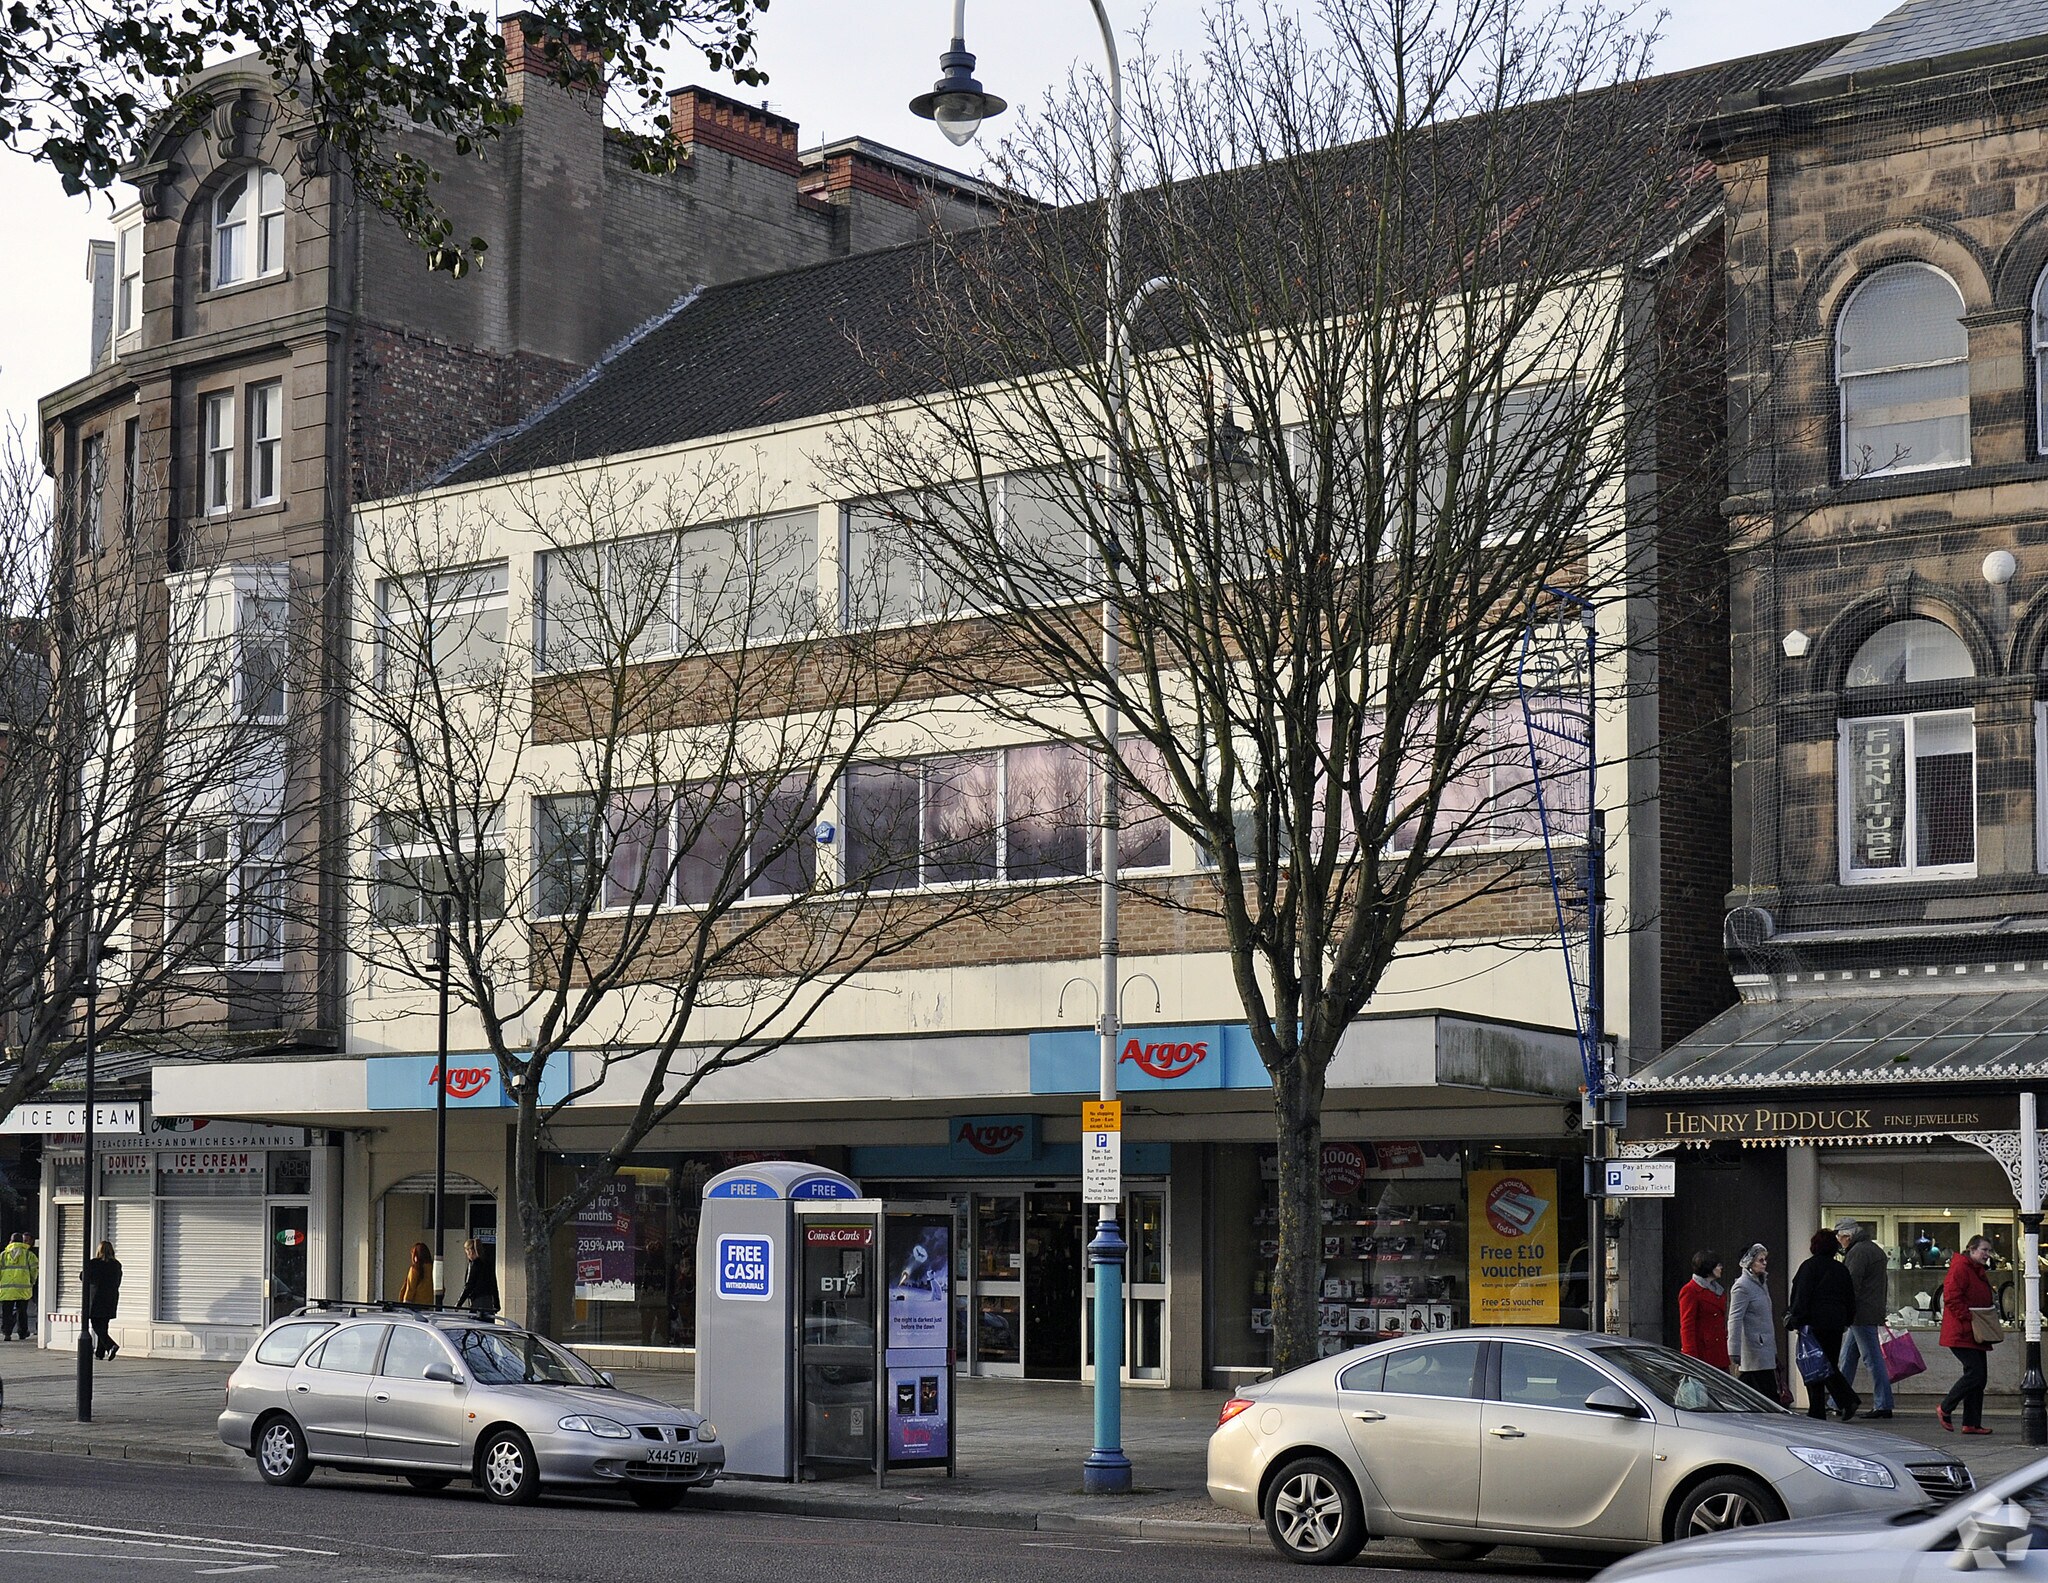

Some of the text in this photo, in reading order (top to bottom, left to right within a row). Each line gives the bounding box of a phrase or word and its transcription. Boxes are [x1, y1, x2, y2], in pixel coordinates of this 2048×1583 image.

[1865, 728, 1892, 860] FURNITURE
[1118, 1037, 1209, 1079] Argos
[22, 1111, 52, 1126] ICE
[1884, 1115, 1912, 1126] FINE
[1913, 1113, 1979, 1128] JEWELLERS
[97, 1136, 294, 1149] TEA COFFEE SANDWICHES PANINIS
[955, 1122, 1025, 1155] Argos
[108, 1155, 147, 1169] DONUTS
[175, 1153, 248, 1167] ICE CREAM
[1321, 1150, 1361, 1168] 1000s
[617, 1182, 627, 1193] to
[730, 1184, 757, 1196] FREE
[811, 1184, 836, 1197] FREE
[1490, 1184, 1504, 1198] Free
[1503, 1181, 1530, 1194] voucher
[598, 1196, 612, 1207] for
[613, 1196, 619, 1207] 3
[578, 1210, 613, 1221] months
[807, 1229, 829, 1241] Coins
[837, 1230, 860, 1241] Cards
[1496, 1222, 1517, 1236] today
[578, 1240, 625, 1252] 29.9% APR
[728, 1245, 762, 1262] FREE
[1480, 1244, 1545, 1260] Free £10
[724, 1263, 765, 1281] CASH
[1481, 1262, 1543, 1278] voucher
[821, 1277, 845, 1292] BT
[1481, 1298, 1499, 1306] Free
[1512, 1298, 1545, 1306] voucher
[647, 1449, 697, 1464] X445 YBV
